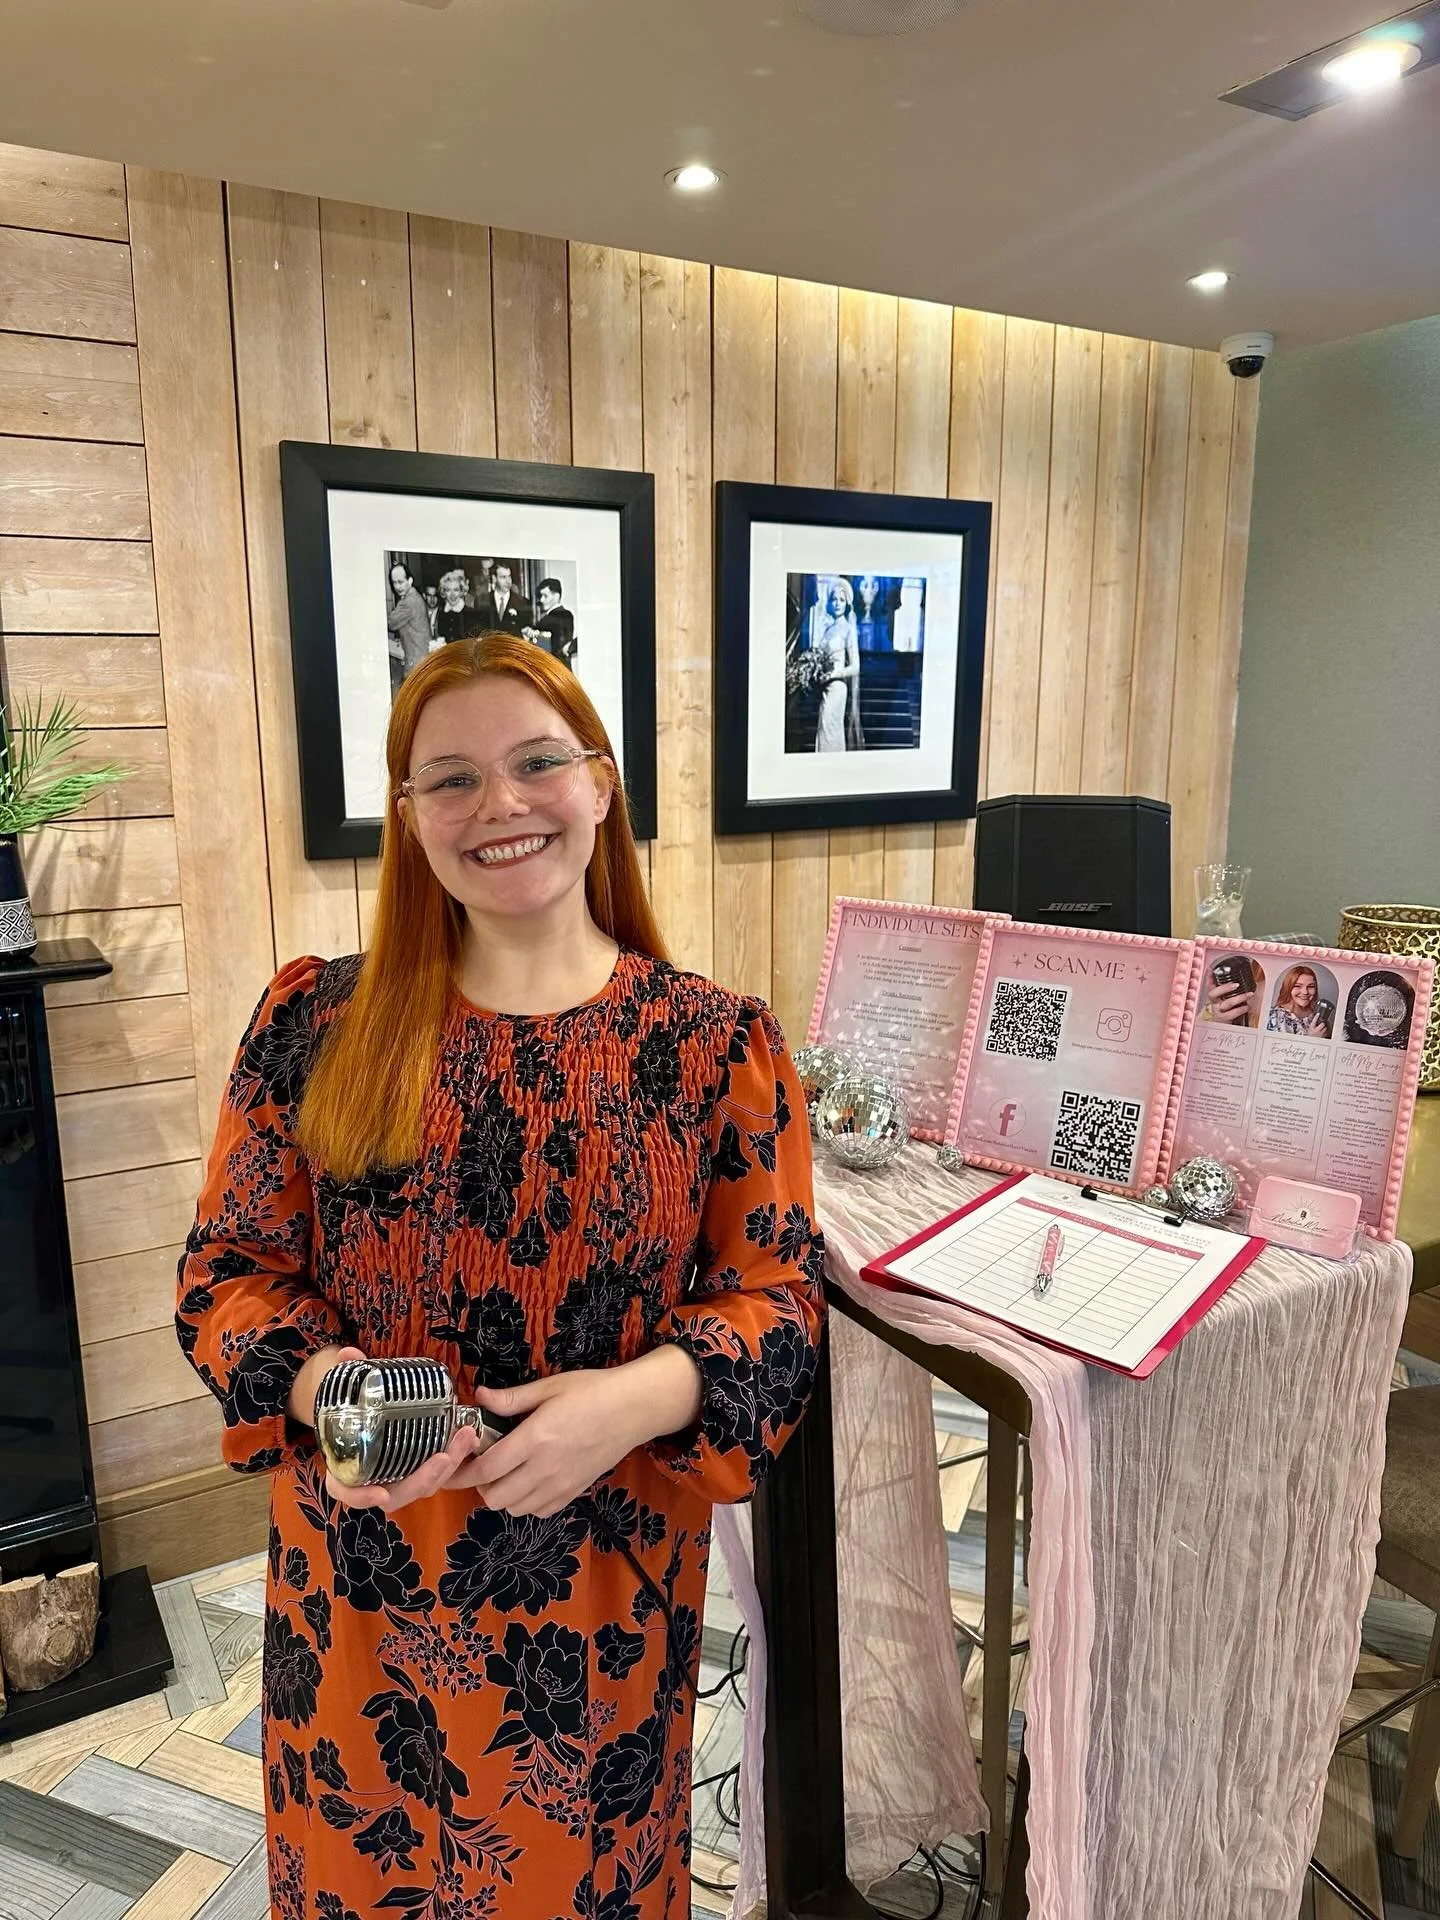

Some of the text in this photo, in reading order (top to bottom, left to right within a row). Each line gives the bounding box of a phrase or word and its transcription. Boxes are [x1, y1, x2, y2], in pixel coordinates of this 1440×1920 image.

[1039, 902, 1112, 912] BOSE
[851, 912, 981, 940] INDIVIDUAL SETS
[1033, 952, 1126, 981] SCAN ME
